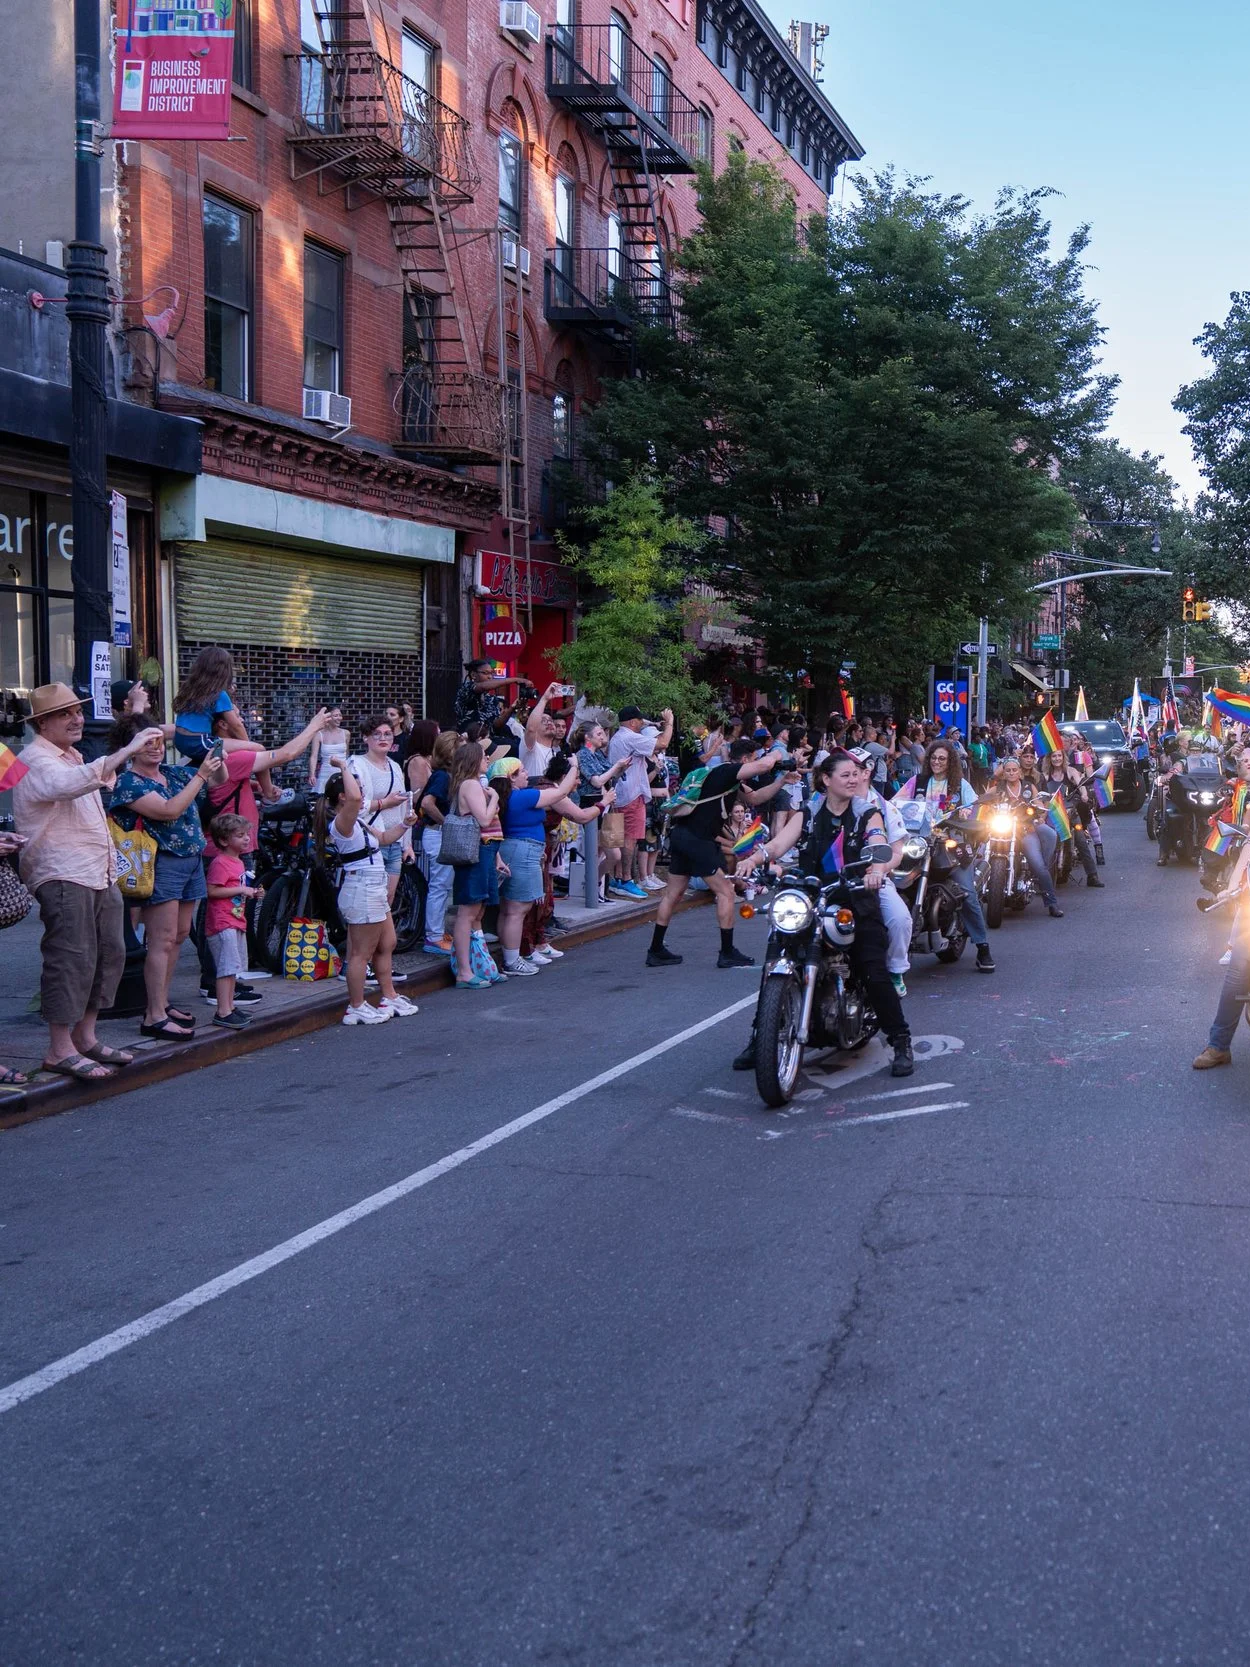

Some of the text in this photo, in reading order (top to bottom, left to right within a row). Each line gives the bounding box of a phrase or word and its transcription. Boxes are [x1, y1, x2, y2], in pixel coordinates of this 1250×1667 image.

[150, 60, 200, 76] BUSINESS
[150, 78, 227, 94] IMPROVEMENT
[148, 96, 195, 112] DISTRICT
[486, 632, 522, 645] PIZZA
[940, 702, 960, 712] GO
